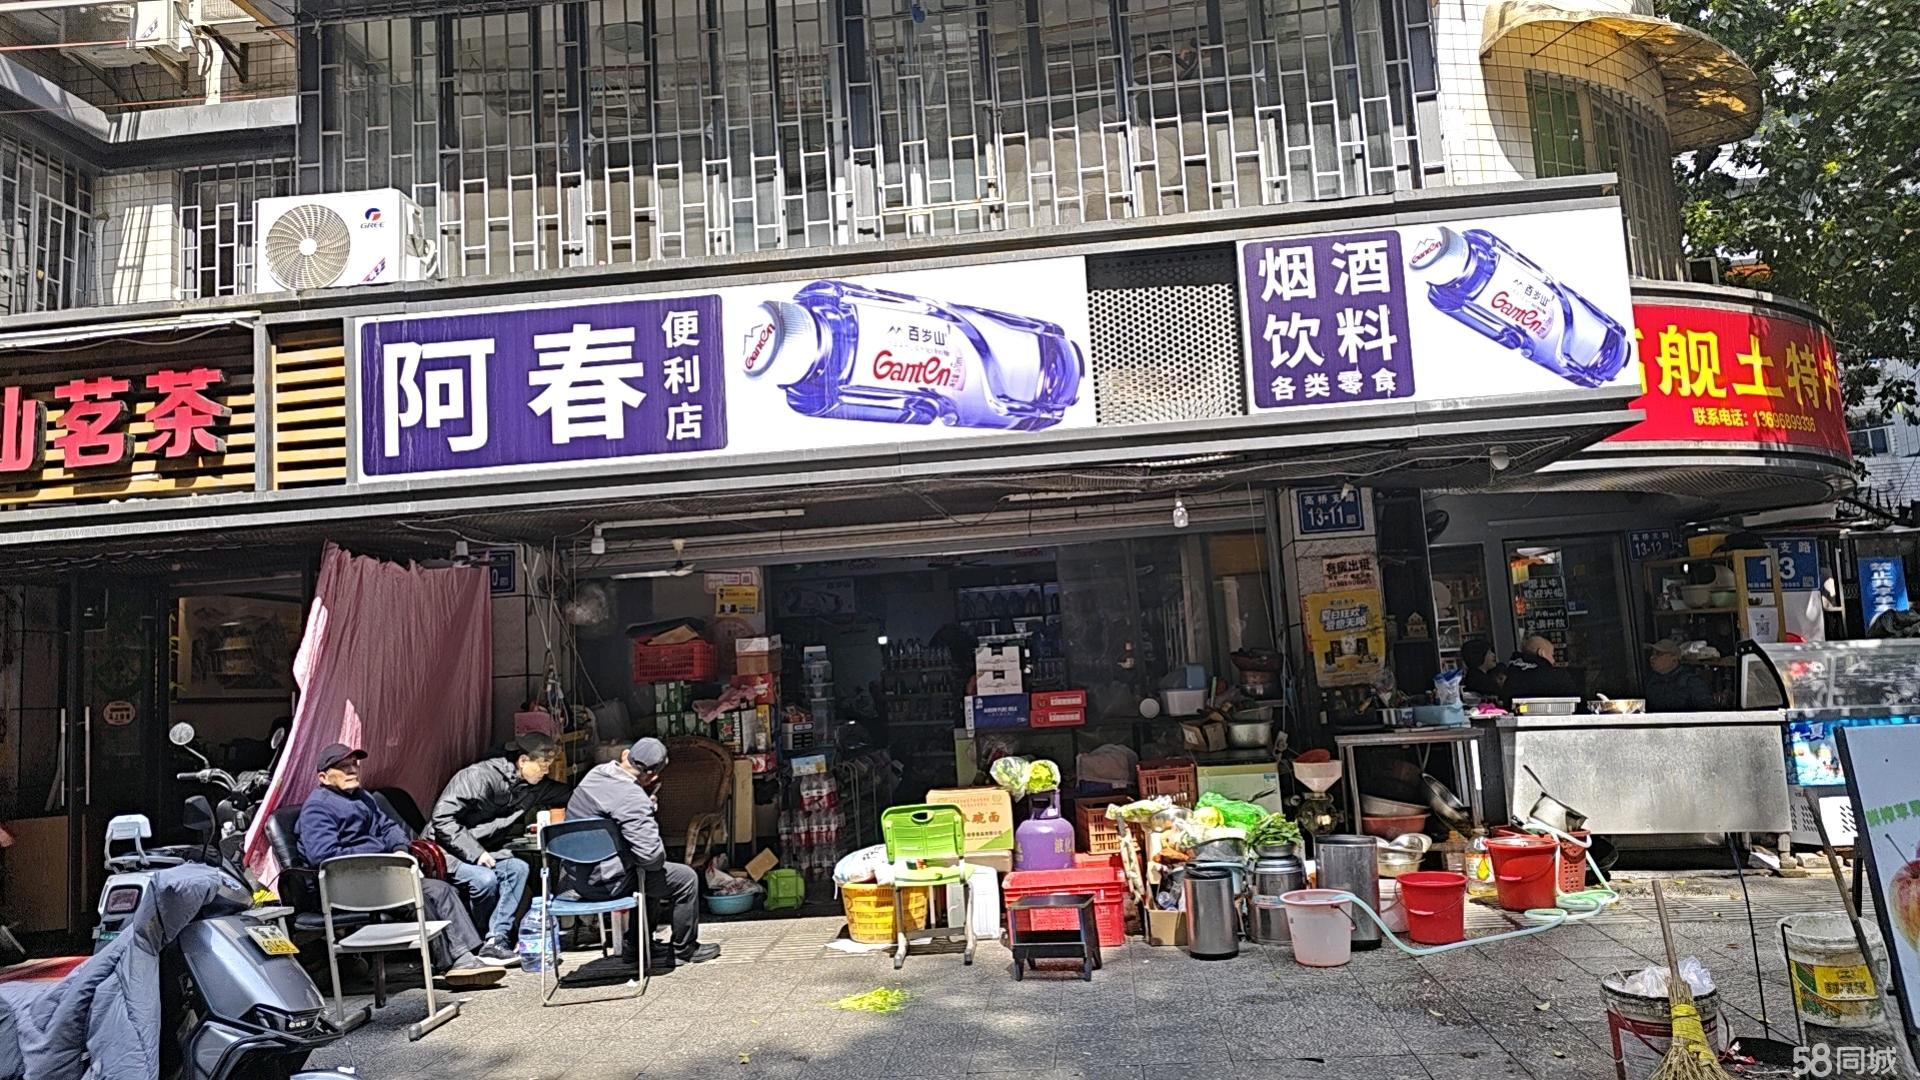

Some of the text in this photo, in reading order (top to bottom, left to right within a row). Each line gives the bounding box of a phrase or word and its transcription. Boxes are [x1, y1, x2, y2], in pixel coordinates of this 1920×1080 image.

[1258, 240, 1391, 302] 烟酒
[1523, 283, 1550, 306] 百岁山
[908, 324, 946, 347] 百岁山
[1263, 304, 1398, 368] 饮料
[383, 323, 647, 457] 阿春
[661, 310, 702, 441] 便利店
[1271, 367, 1398, 401] 各类零食
[1634, 324, 1841, 412] 舰土特产
[0, 368, 232, 472] 山茗茶
[1308, 506, 1344, 526] 13-11
[1760, 556, 1796, 580] 13
